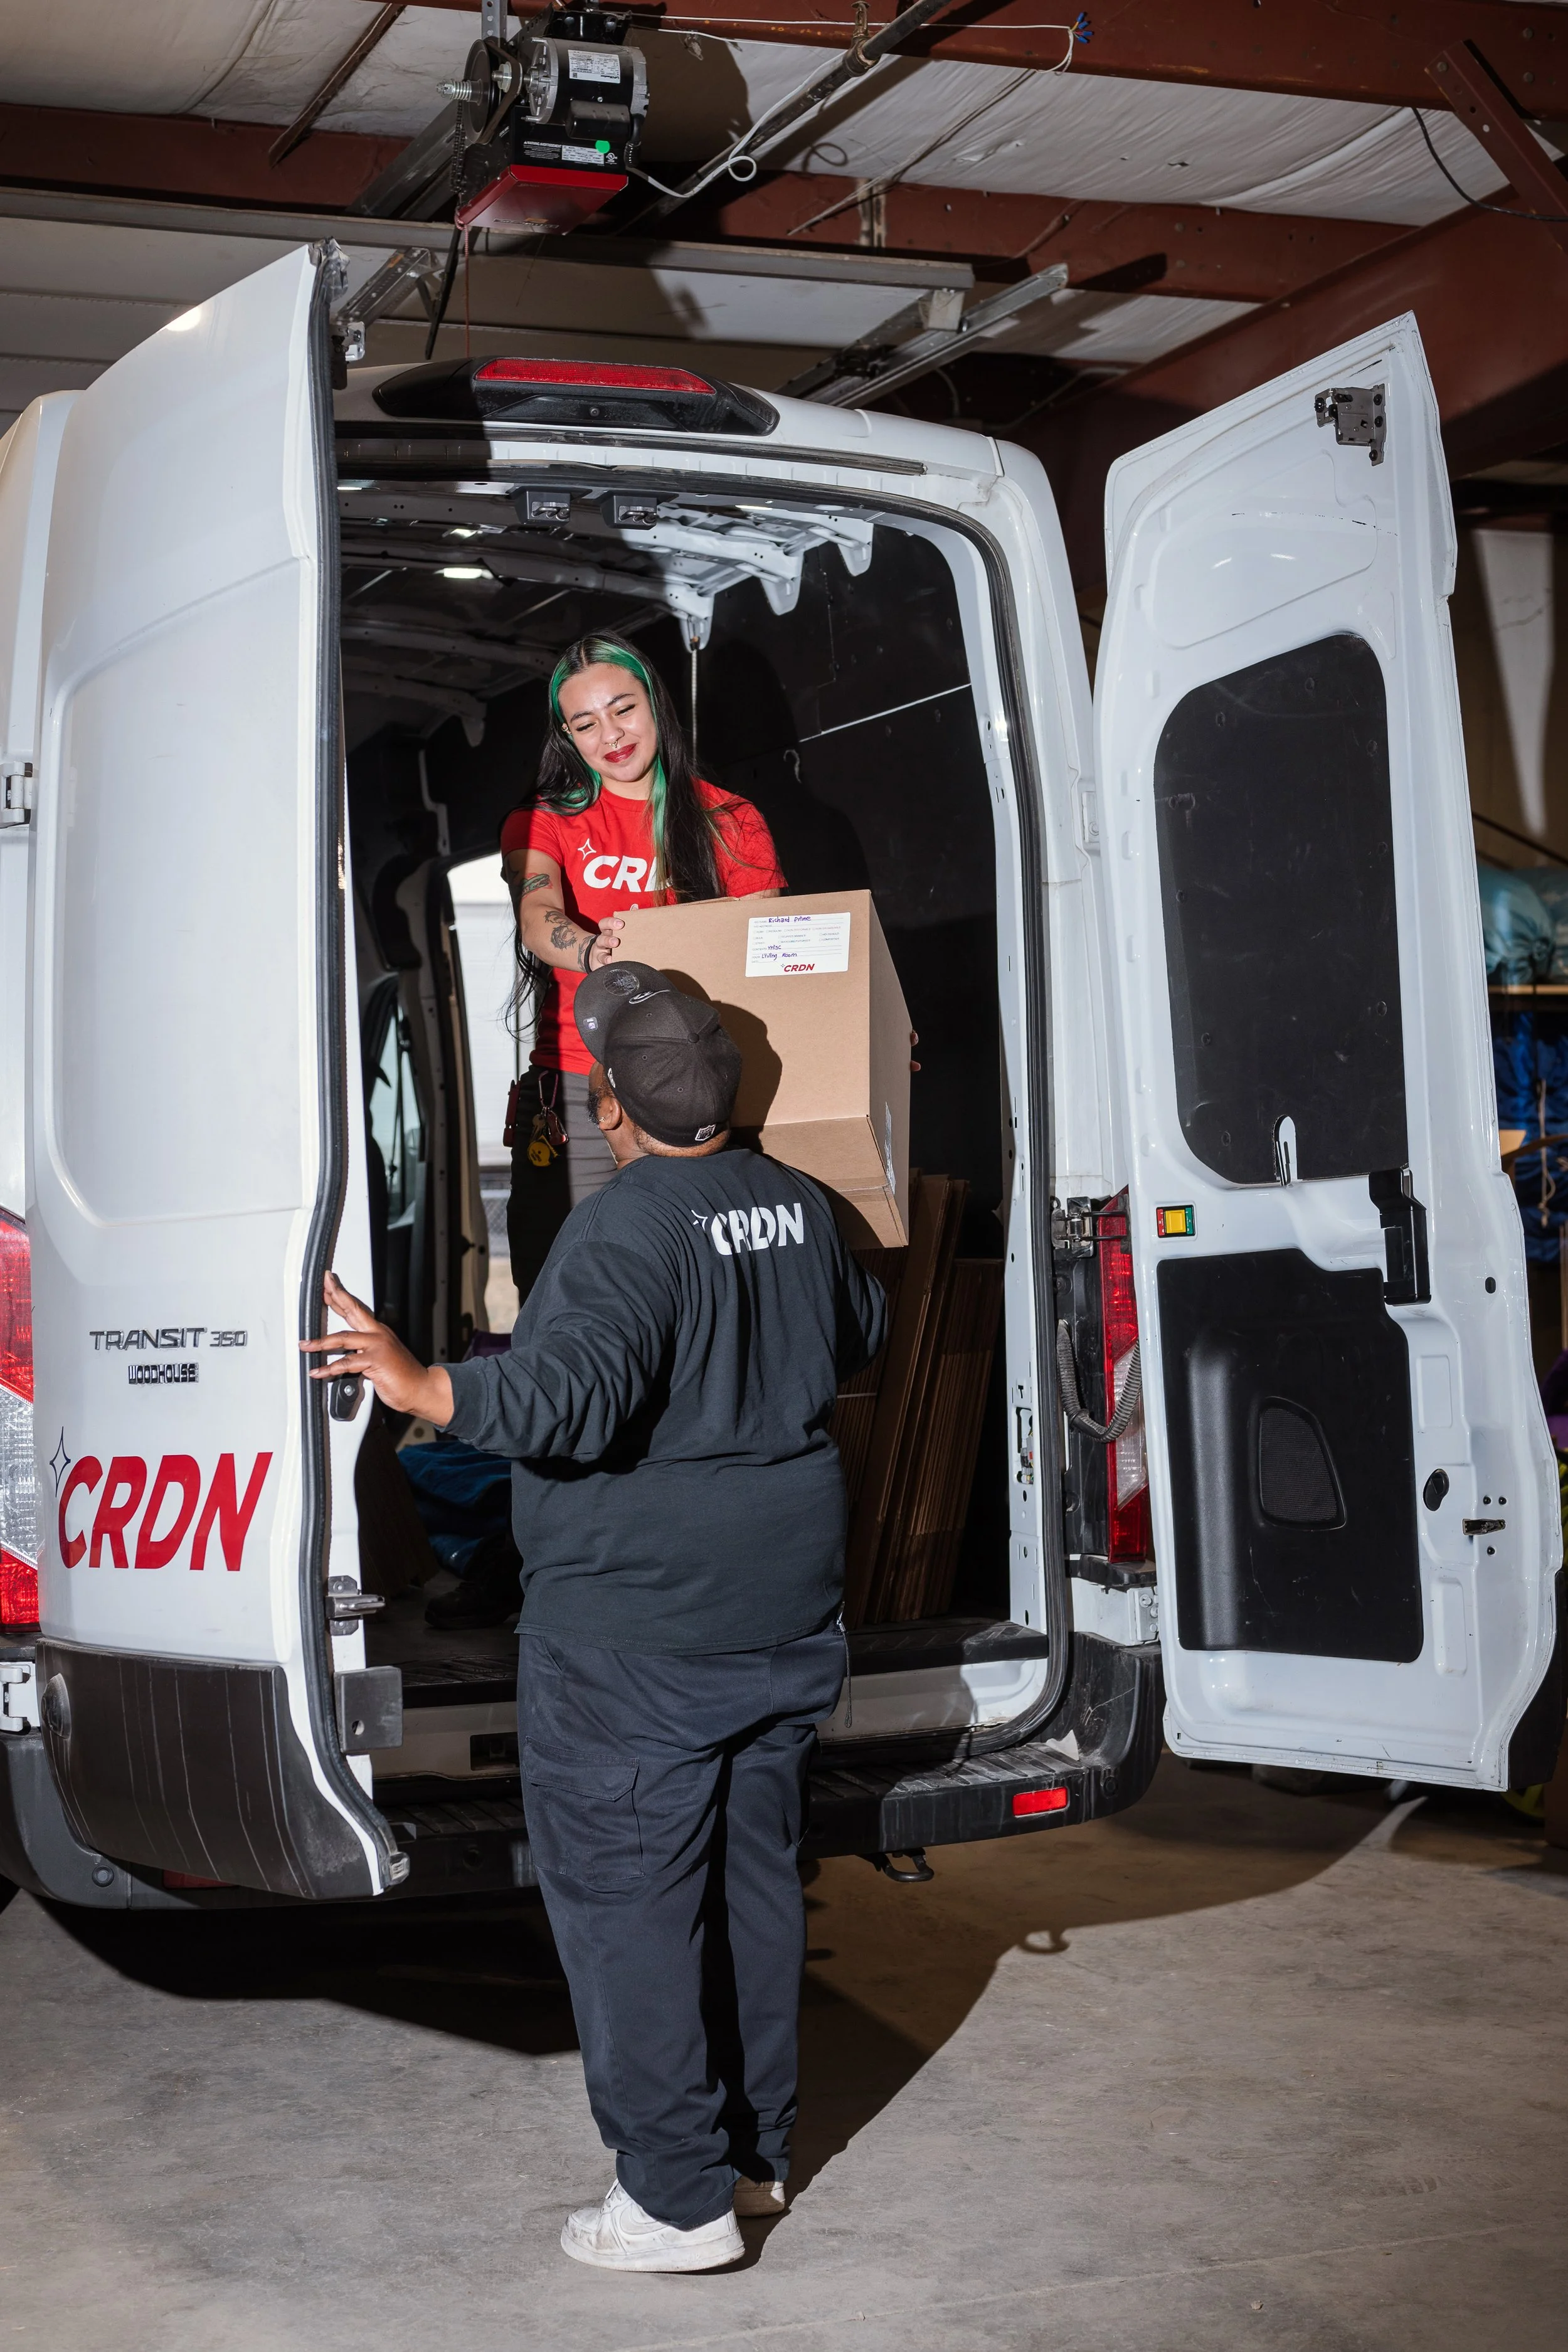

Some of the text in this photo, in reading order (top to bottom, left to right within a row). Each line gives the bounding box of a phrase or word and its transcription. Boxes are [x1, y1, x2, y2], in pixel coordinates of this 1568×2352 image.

[783, 963, 815, 972] CRDN
[711, 1202, 804, 1256] CRDN
[89, 1327, 248, 1350] TRANSIT 350
[127, 1362, 199, 1385] WOODHOUSE
[58, 1452, 273, 1572] CRDN
